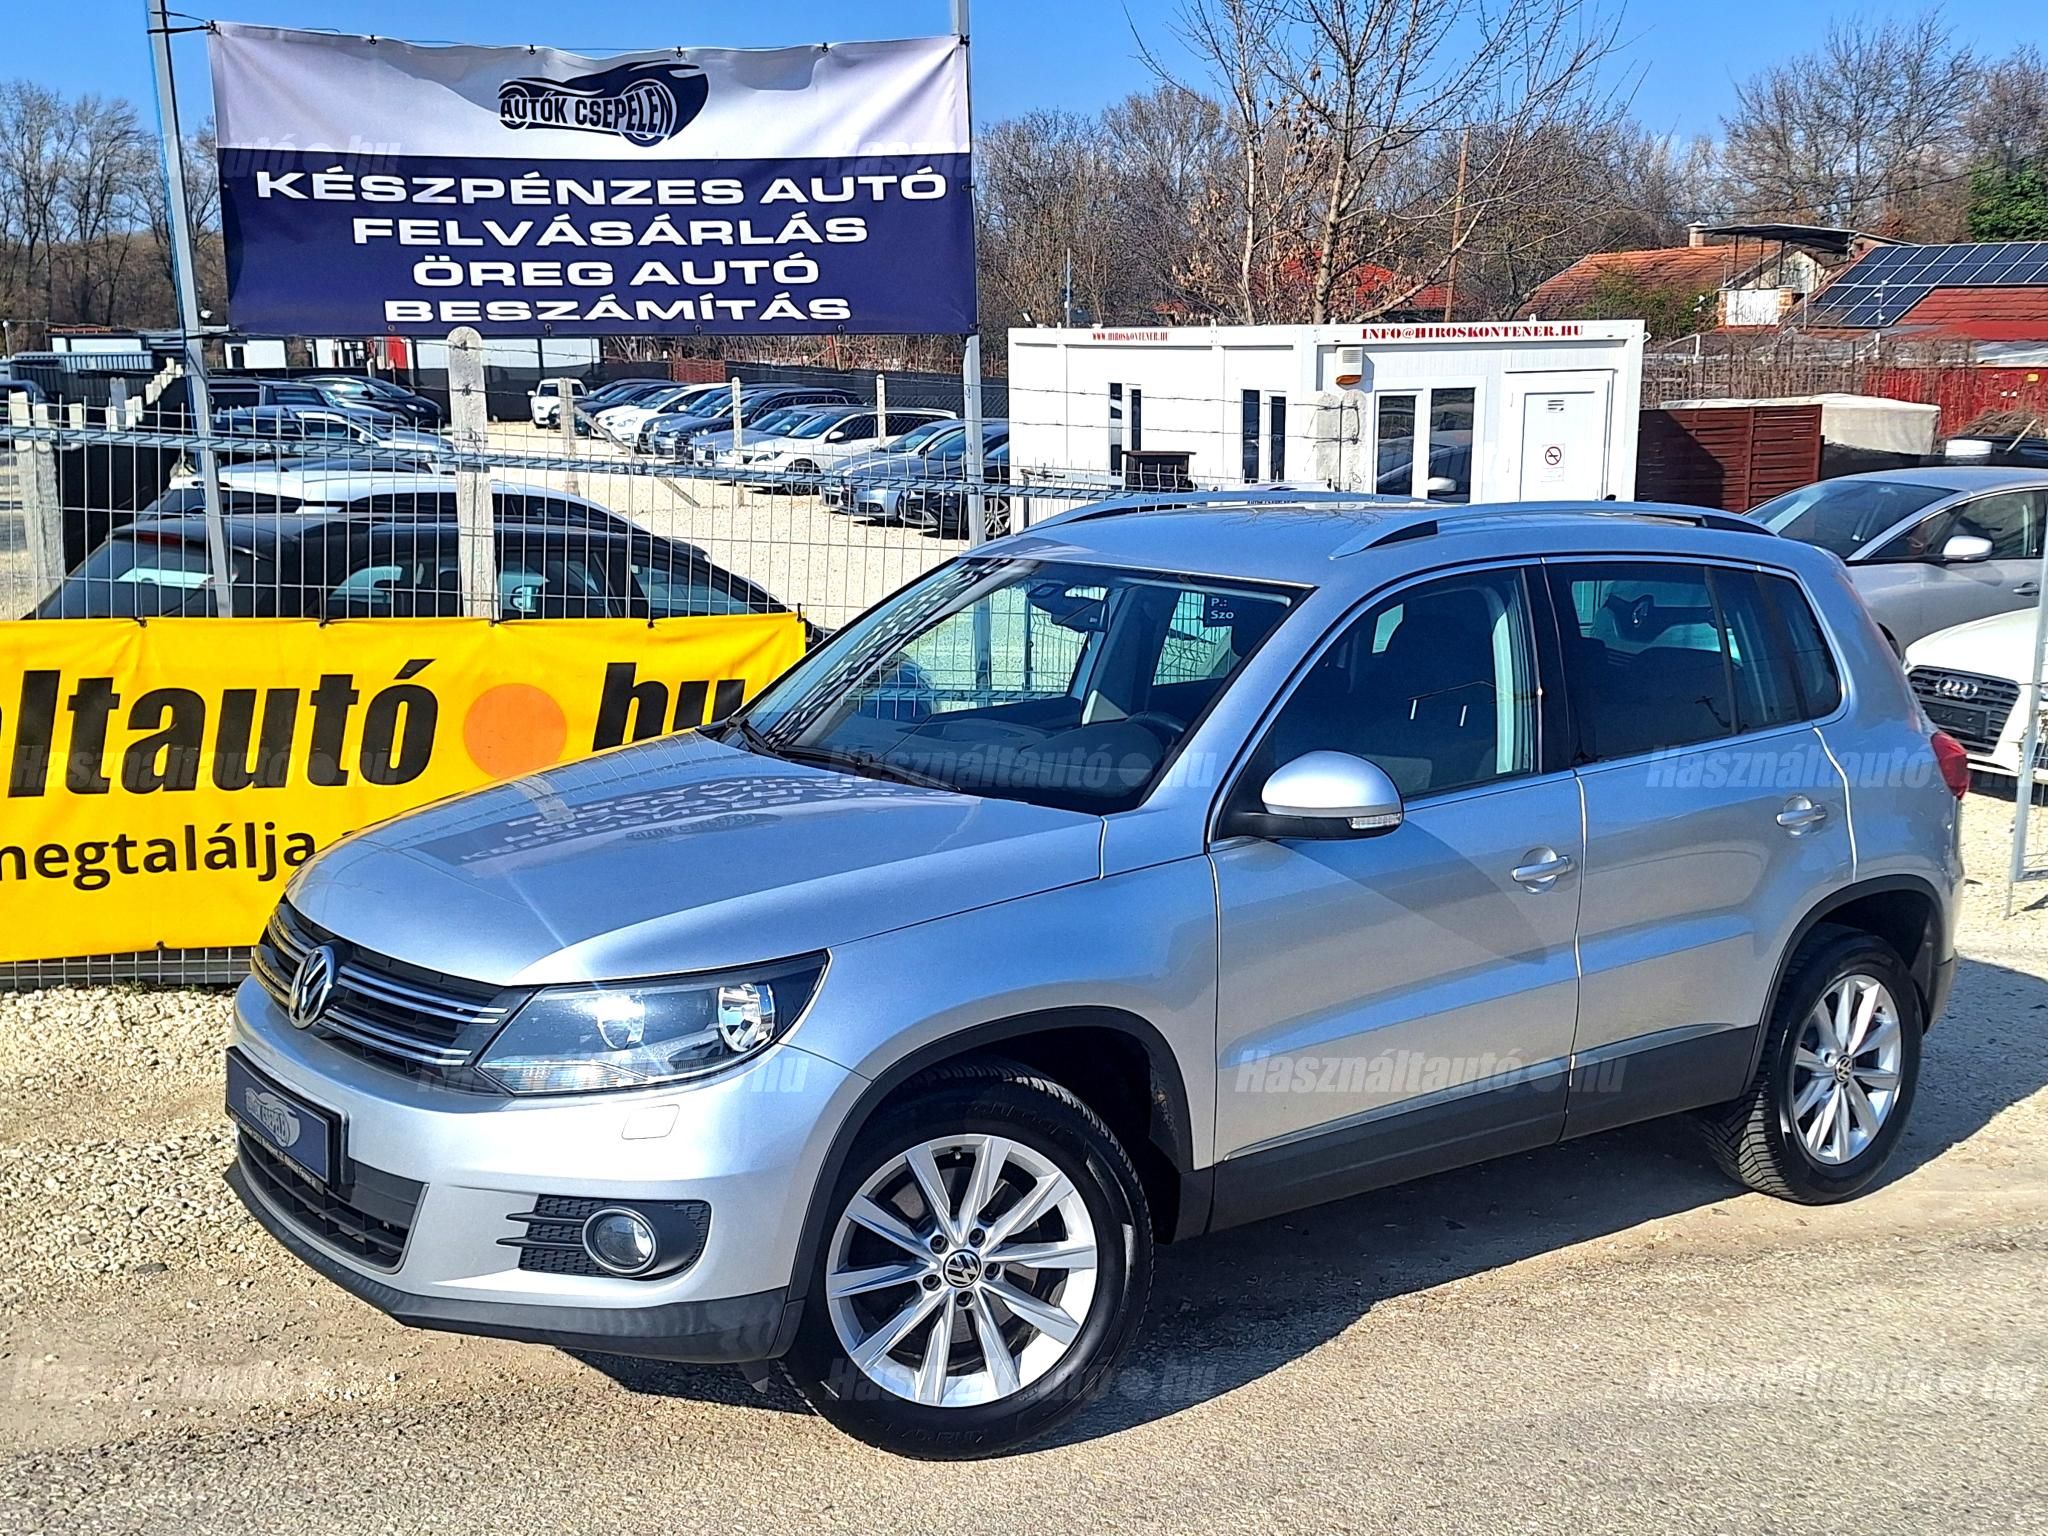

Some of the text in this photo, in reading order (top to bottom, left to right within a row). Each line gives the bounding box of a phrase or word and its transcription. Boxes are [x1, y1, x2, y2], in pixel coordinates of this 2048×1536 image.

[575, 85, 669, 134] CSEPELEN
[256, 166, 947, 205] KÉSZPÉNZES AUTÓ
[352, 214, 868, 246] FELVÁSÁRLÁS
[412, 253, 819, 288] ÖREG AUTÓ
[384, 294, 852, 324] BESZÁMÍTÁS
[1362, 325, 1584, 340] INFO@HIROSKONTENER.HU
[1210, 610, 1235, 620] Szo
[0, 659, 439, 798] ltautó
